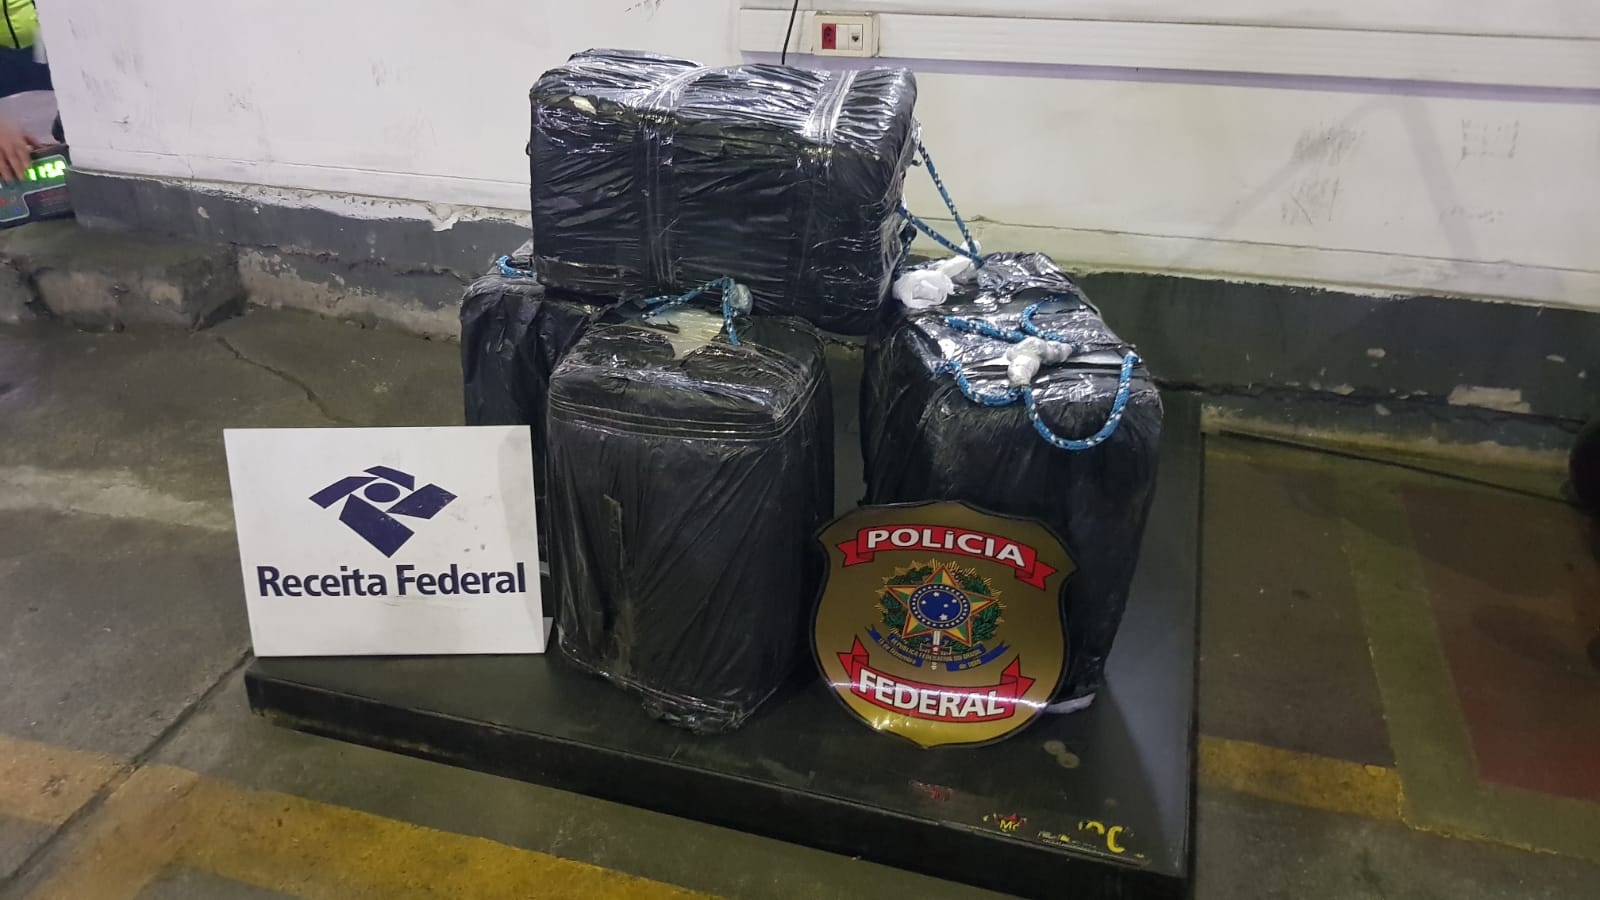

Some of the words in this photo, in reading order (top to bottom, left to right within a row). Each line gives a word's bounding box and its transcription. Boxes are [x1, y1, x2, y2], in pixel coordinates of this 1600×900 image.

[256, 565, 387, 597] Receita
[395, 562, 527, 596] Federal
[859, 668, 1005, 718] FEDERAL
